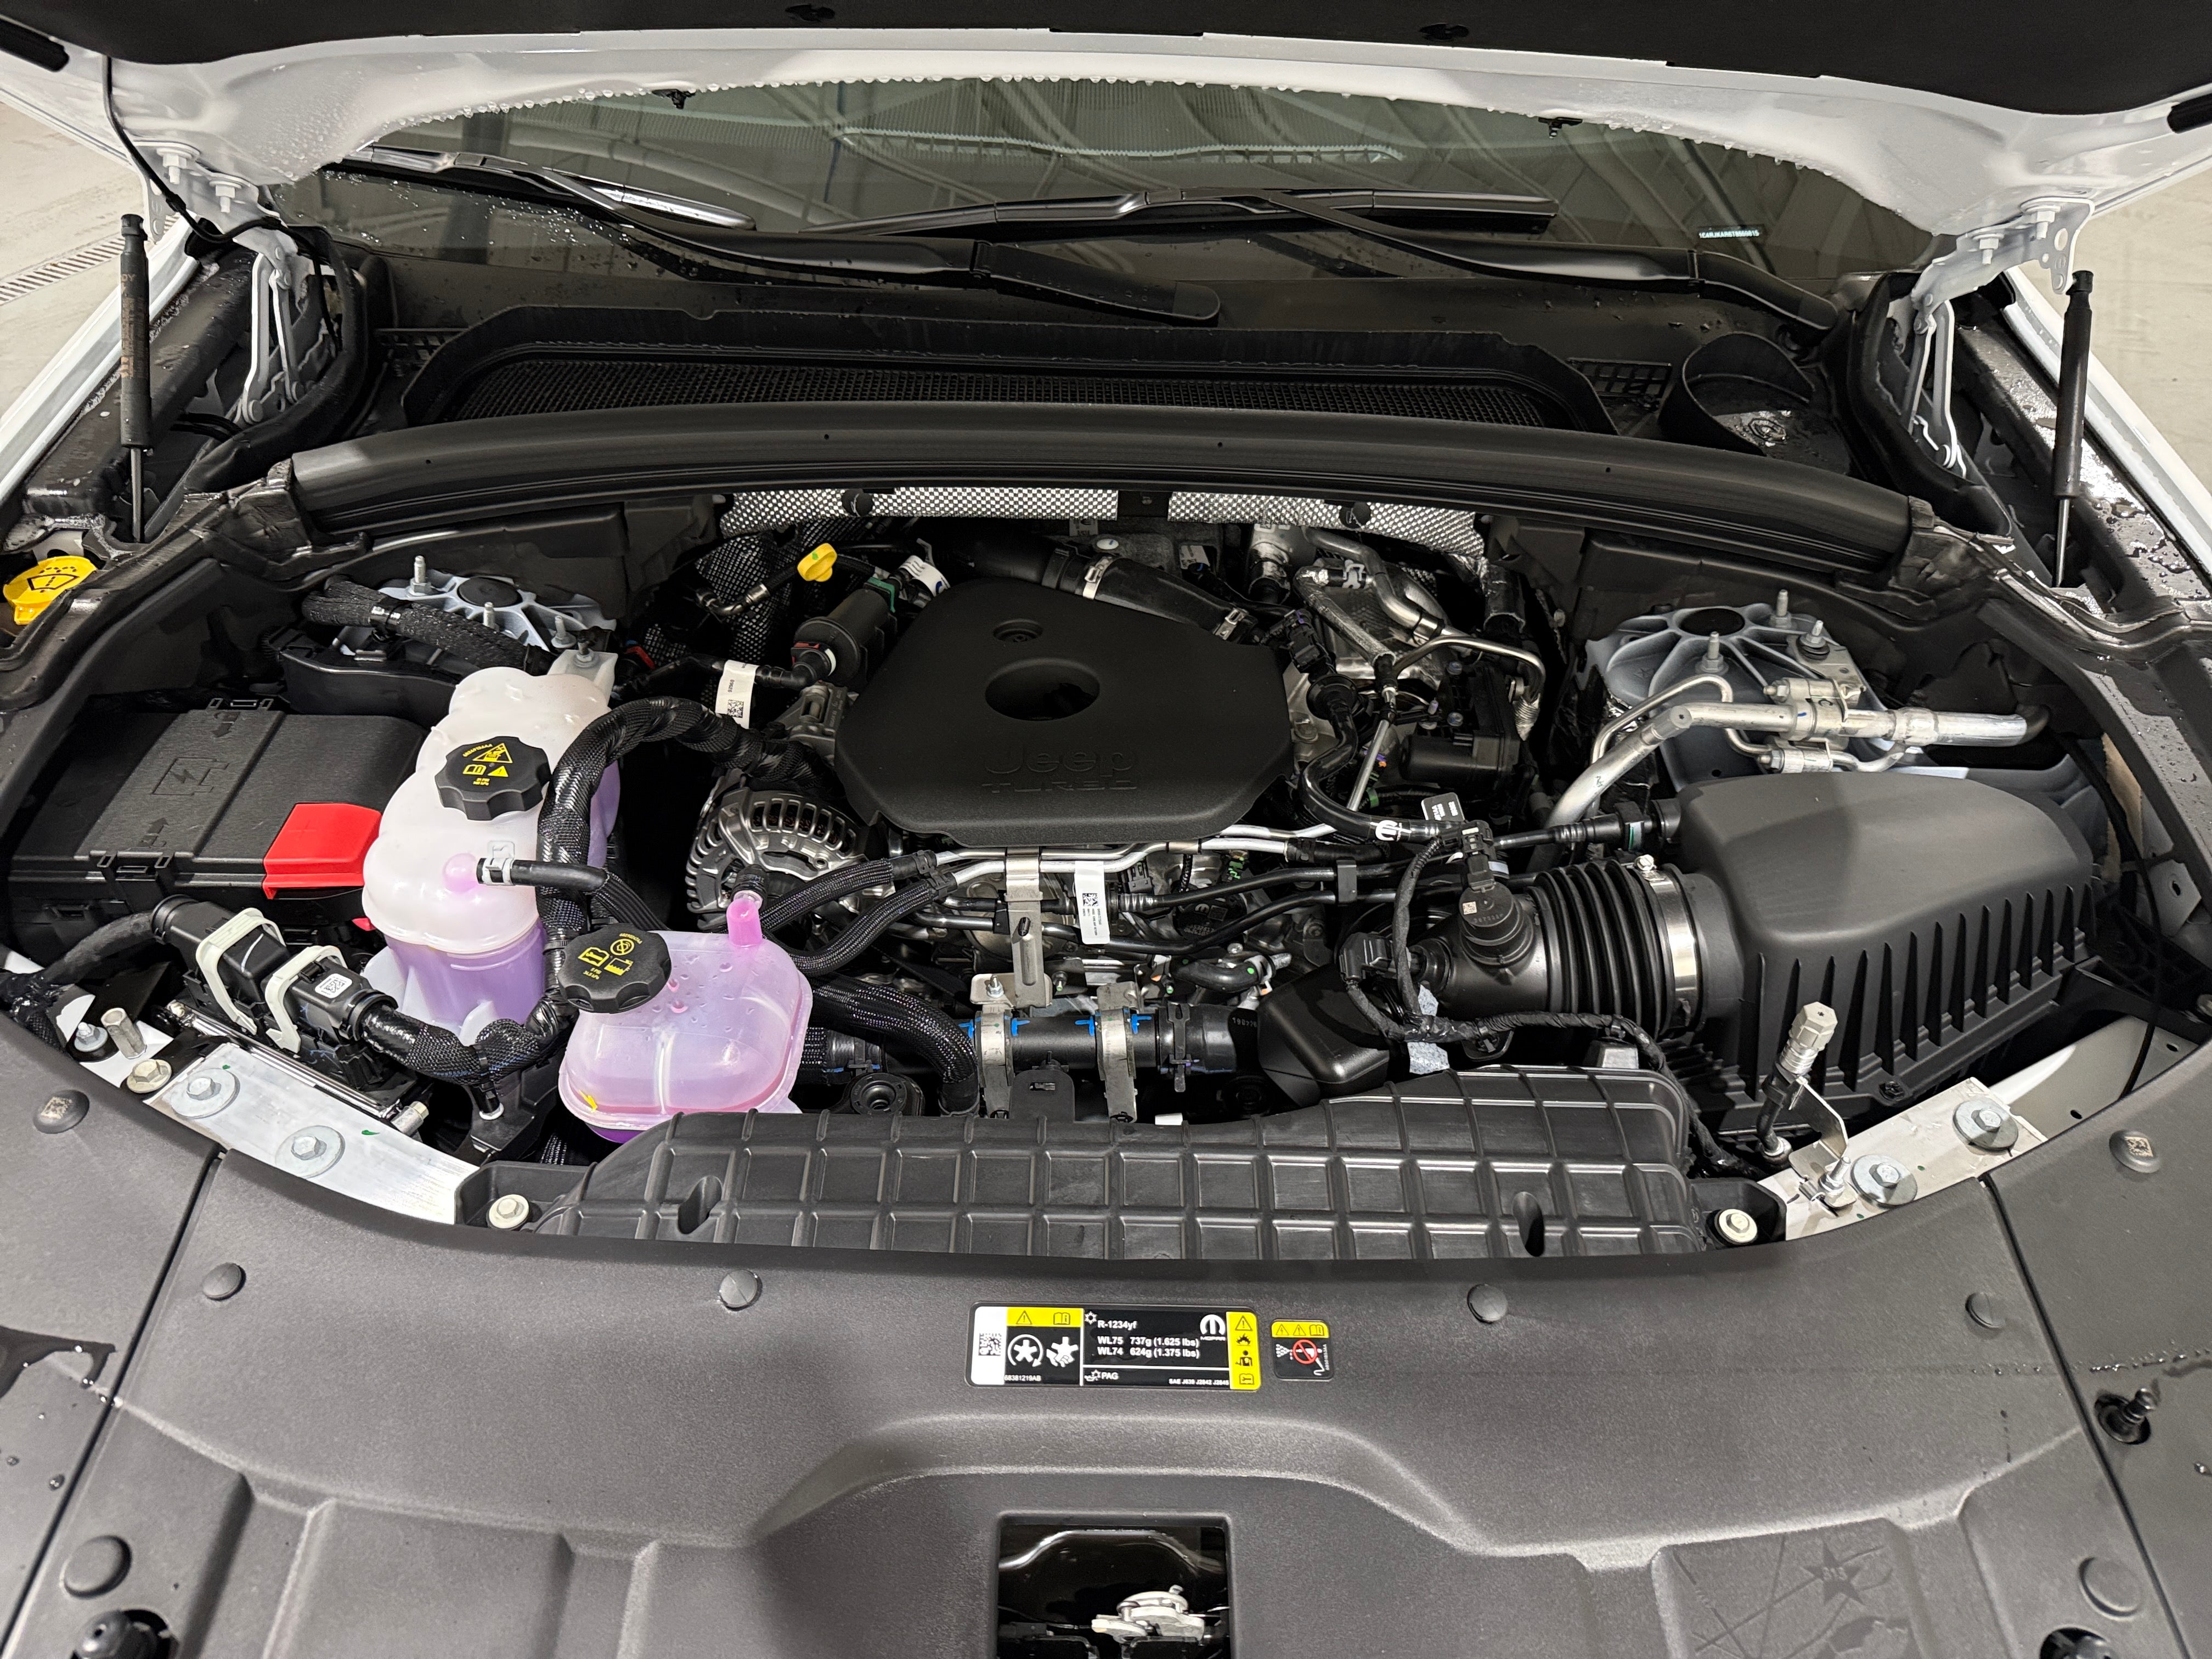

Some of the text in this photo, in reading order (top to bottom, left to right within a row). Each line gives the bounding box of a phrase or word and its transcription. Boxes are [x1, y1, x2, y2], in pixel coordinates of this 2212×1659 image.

[985, 746, 1137, 777] Jeep
[1097, 1320, 1137, 1330] R-1234yf
[1097, 1336, 1200, 1348] WL75 737g (1.625 lbs)
[1097, 1347, 1200, 1359] WL74 624g (1.375 lbs)
[1101, 1372, 1119, 1380] PAG
